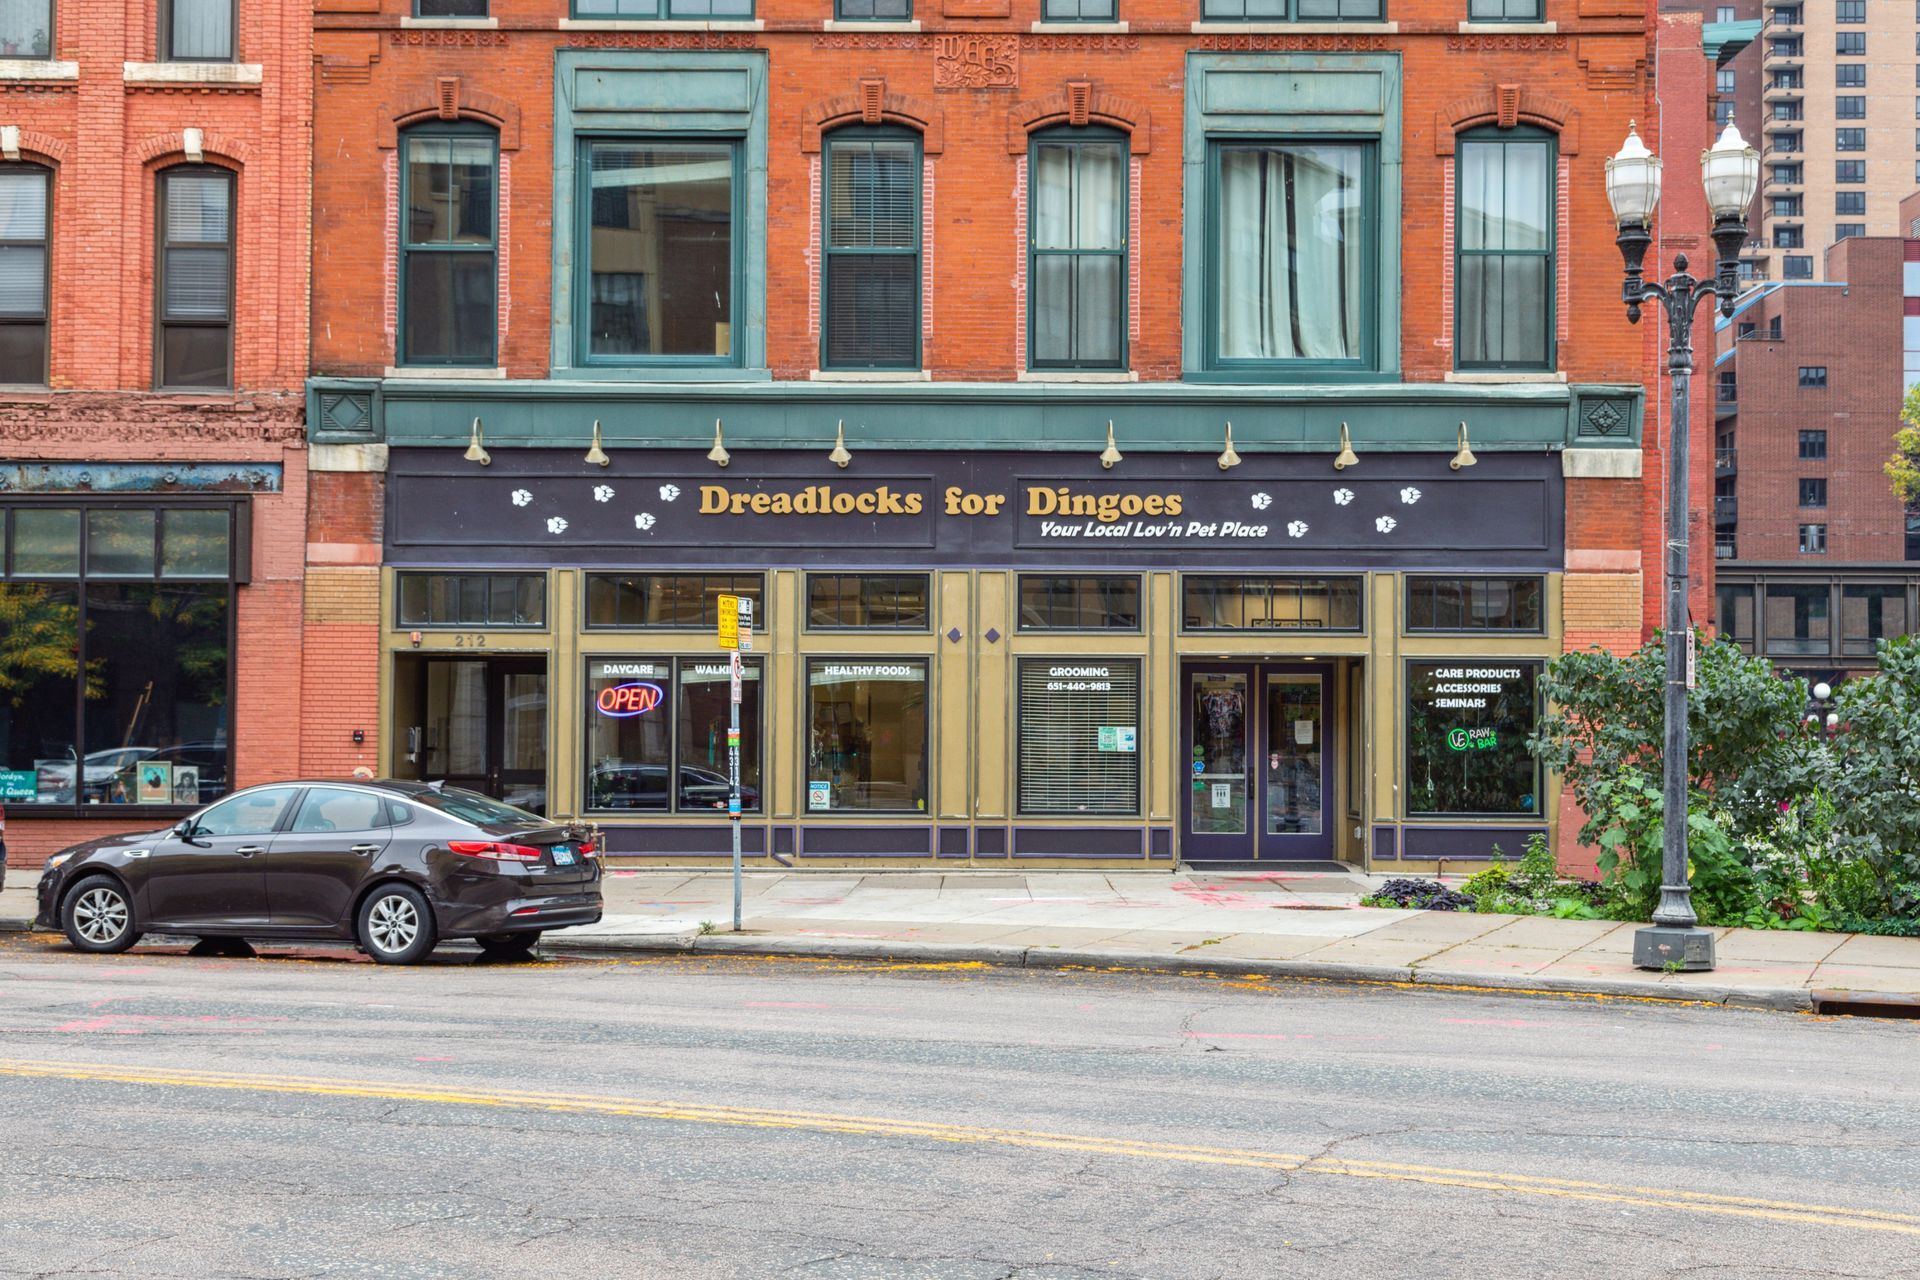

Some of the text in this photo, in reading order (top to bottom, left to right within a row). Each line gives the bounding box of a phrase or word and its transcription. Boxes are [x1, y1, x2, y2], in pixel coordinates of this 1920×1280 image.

[698, 485, 1183, 523] Dreadlocks for Dingoes
[1040, 521, 1268, 538] Your Local Lov'n Pet Place
[455, 634, 486, 648] 212
[603, 664, 654, 675] DAYCARE
[695, 664, 746, 675] WALKIG
[824, 665, 911, 676] HEALTHY FOODS
[1049, 667, 1109, 677] GROOMING
[1435, 668, 1464, 679] CARE
[1465, 668, 1521, 679] PRODUCTS
[1047, 682, 1111, 691] 651-440-9813
[1435, 683, 1502, 693] ACCESSORIES
[599, 687, 657, 711] OPEN
[1435, 698, 1487, 708] SEMINARS
[1468, 727, 1490, 739] RAW
[1476, 736, 1497, 750] BAR
[7, 787, 35, 796] Queen
